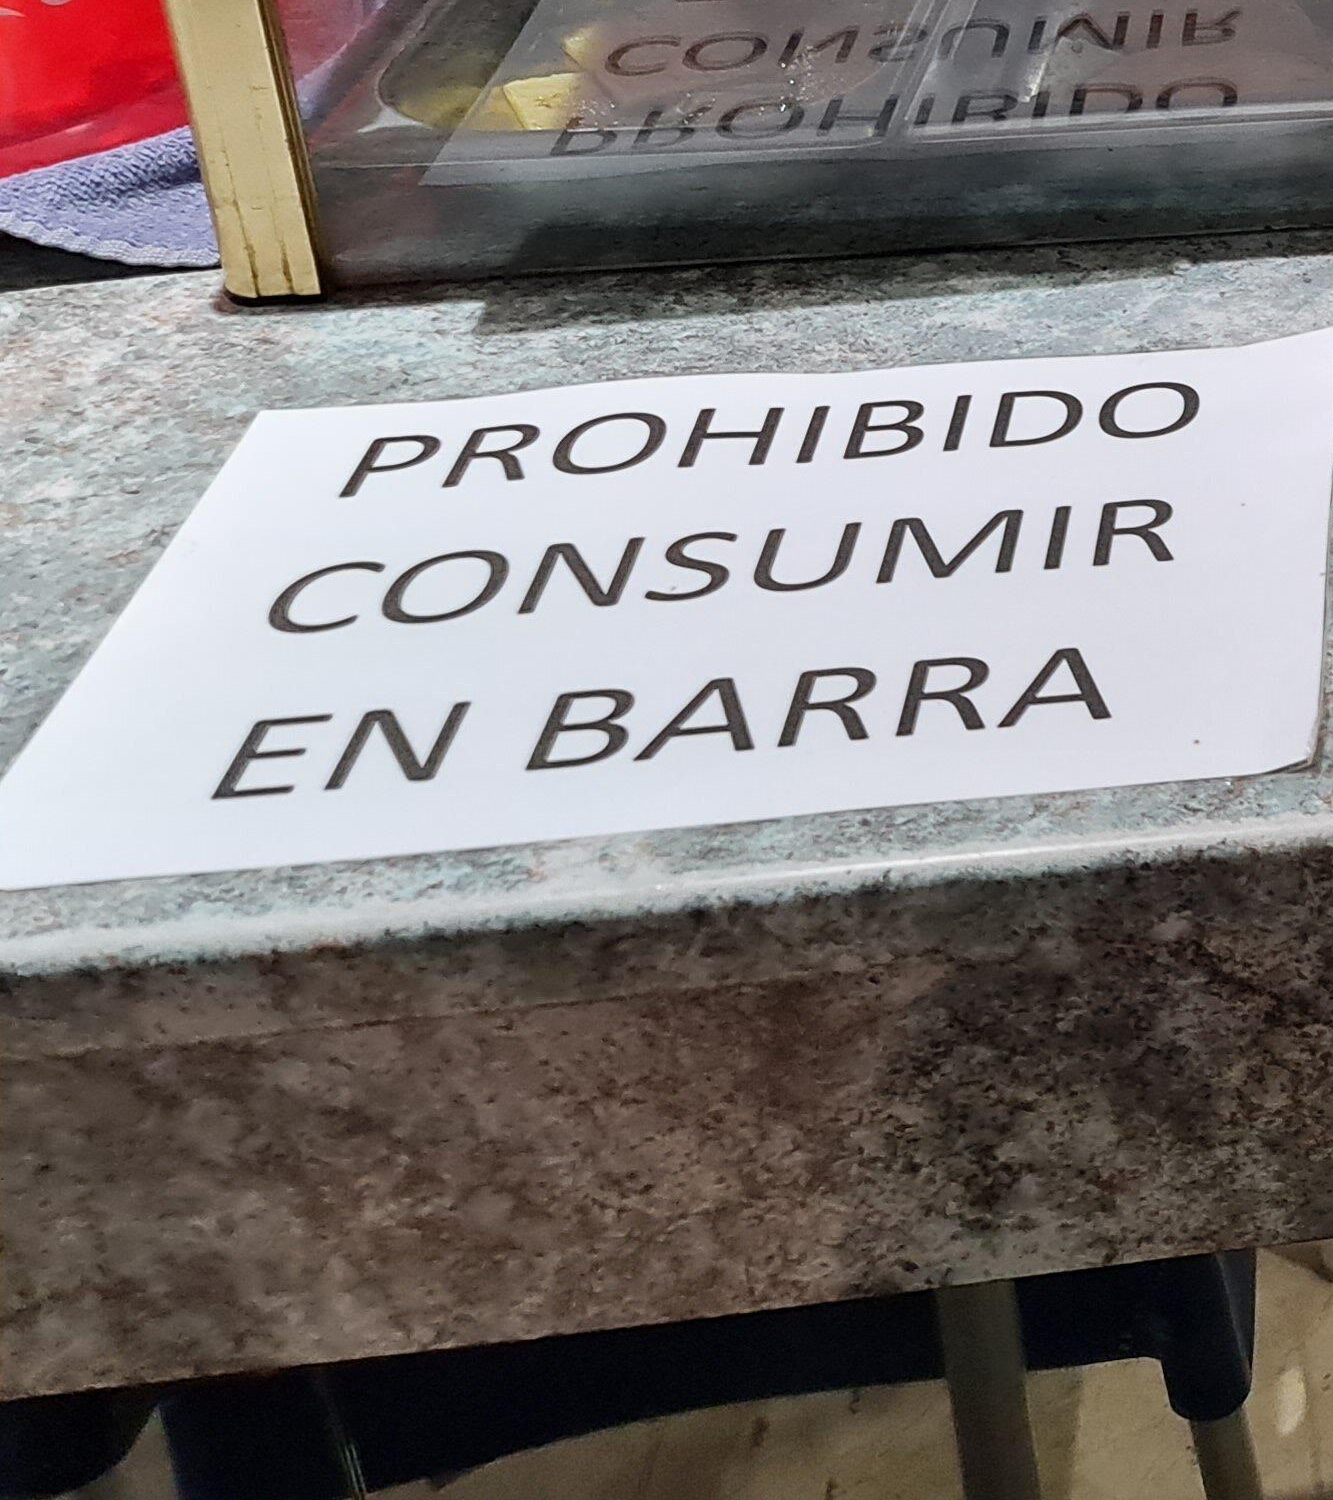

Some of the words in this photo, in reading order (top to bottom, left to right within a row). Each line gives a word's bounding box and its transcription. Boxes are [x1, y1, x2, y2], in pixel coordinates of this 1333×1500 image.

[338, 380, 1201, 498] PROHIBIDO
[264, 498, 1176, 635] CONSUMIR
[209, 700, 472, 801] EN
[524, 646, 1114, 773] BARRA
